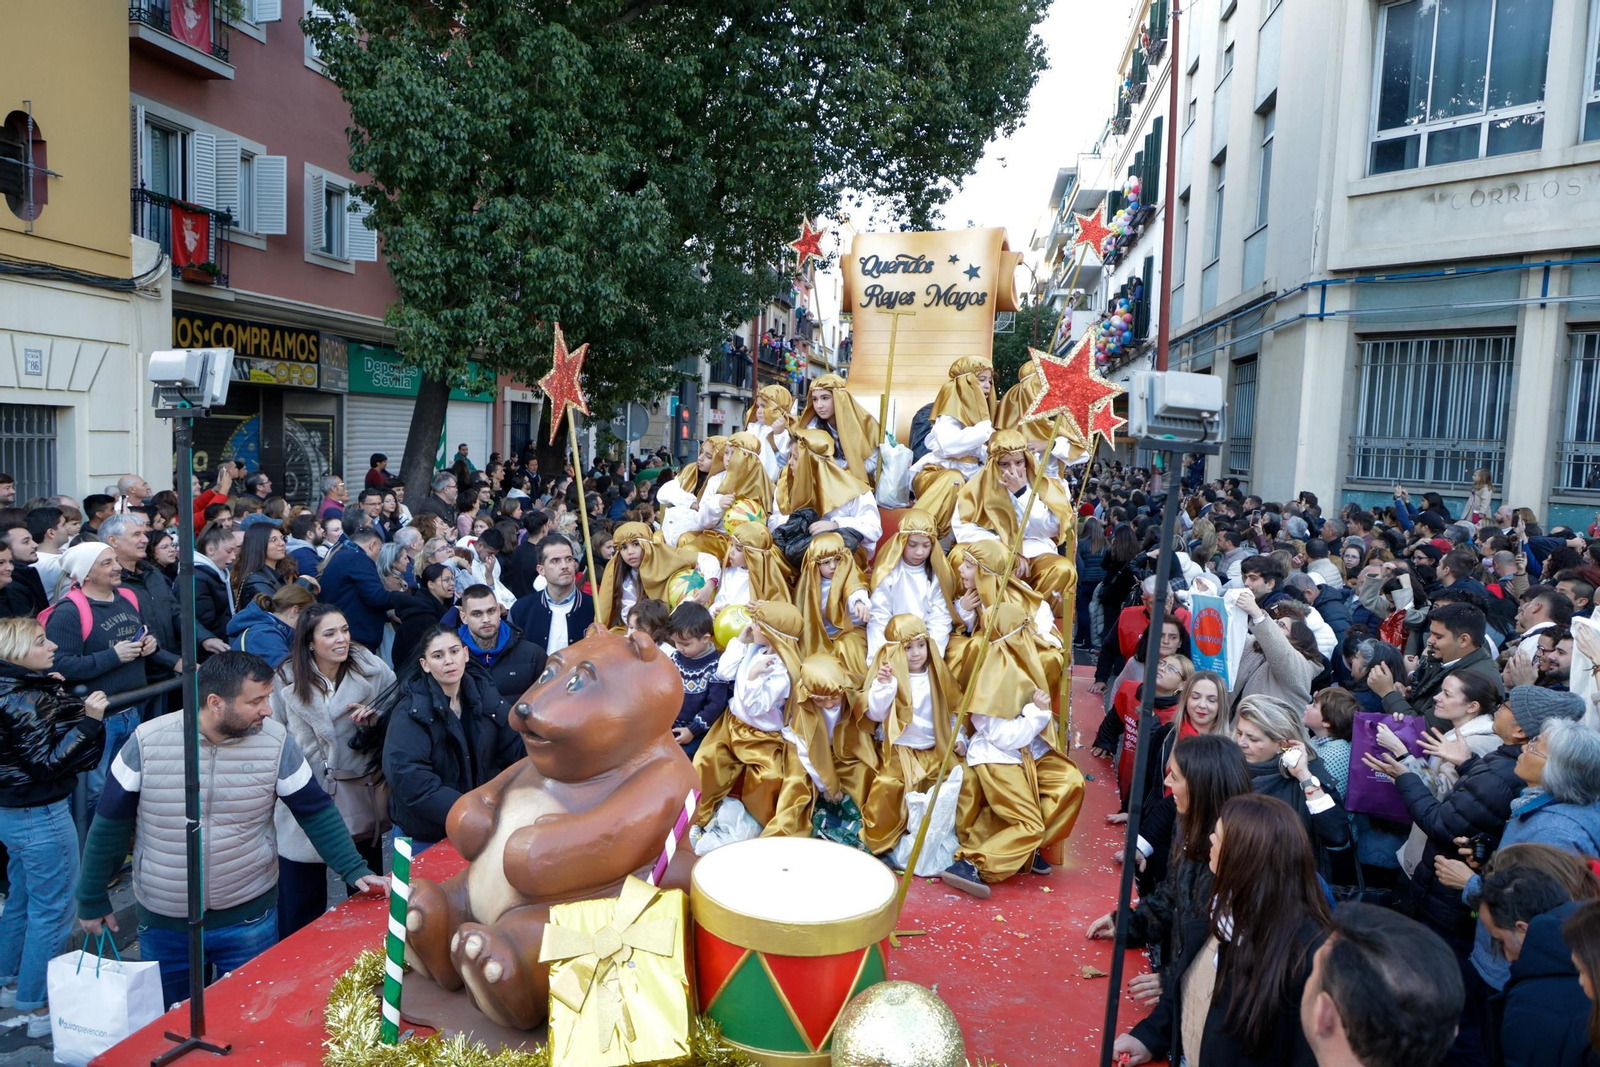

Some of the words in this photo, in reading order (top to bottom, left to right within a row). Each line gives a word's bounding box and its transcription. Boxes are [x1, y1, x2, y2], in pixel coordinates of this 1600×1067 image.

[1451, 177, 1581, 210] CORREOS
[859, 254, 934, 278] Queridos
[860, 284, 916, 310] Reyes
[923, 283, 988, 311] Magos
[210, 321, 318, 362] COMPRAMOS
[275, 361, 316, 386] ORO
[372, 372, 412, 389] Sevilla
[101, 612, 128, 632] CALVIN
